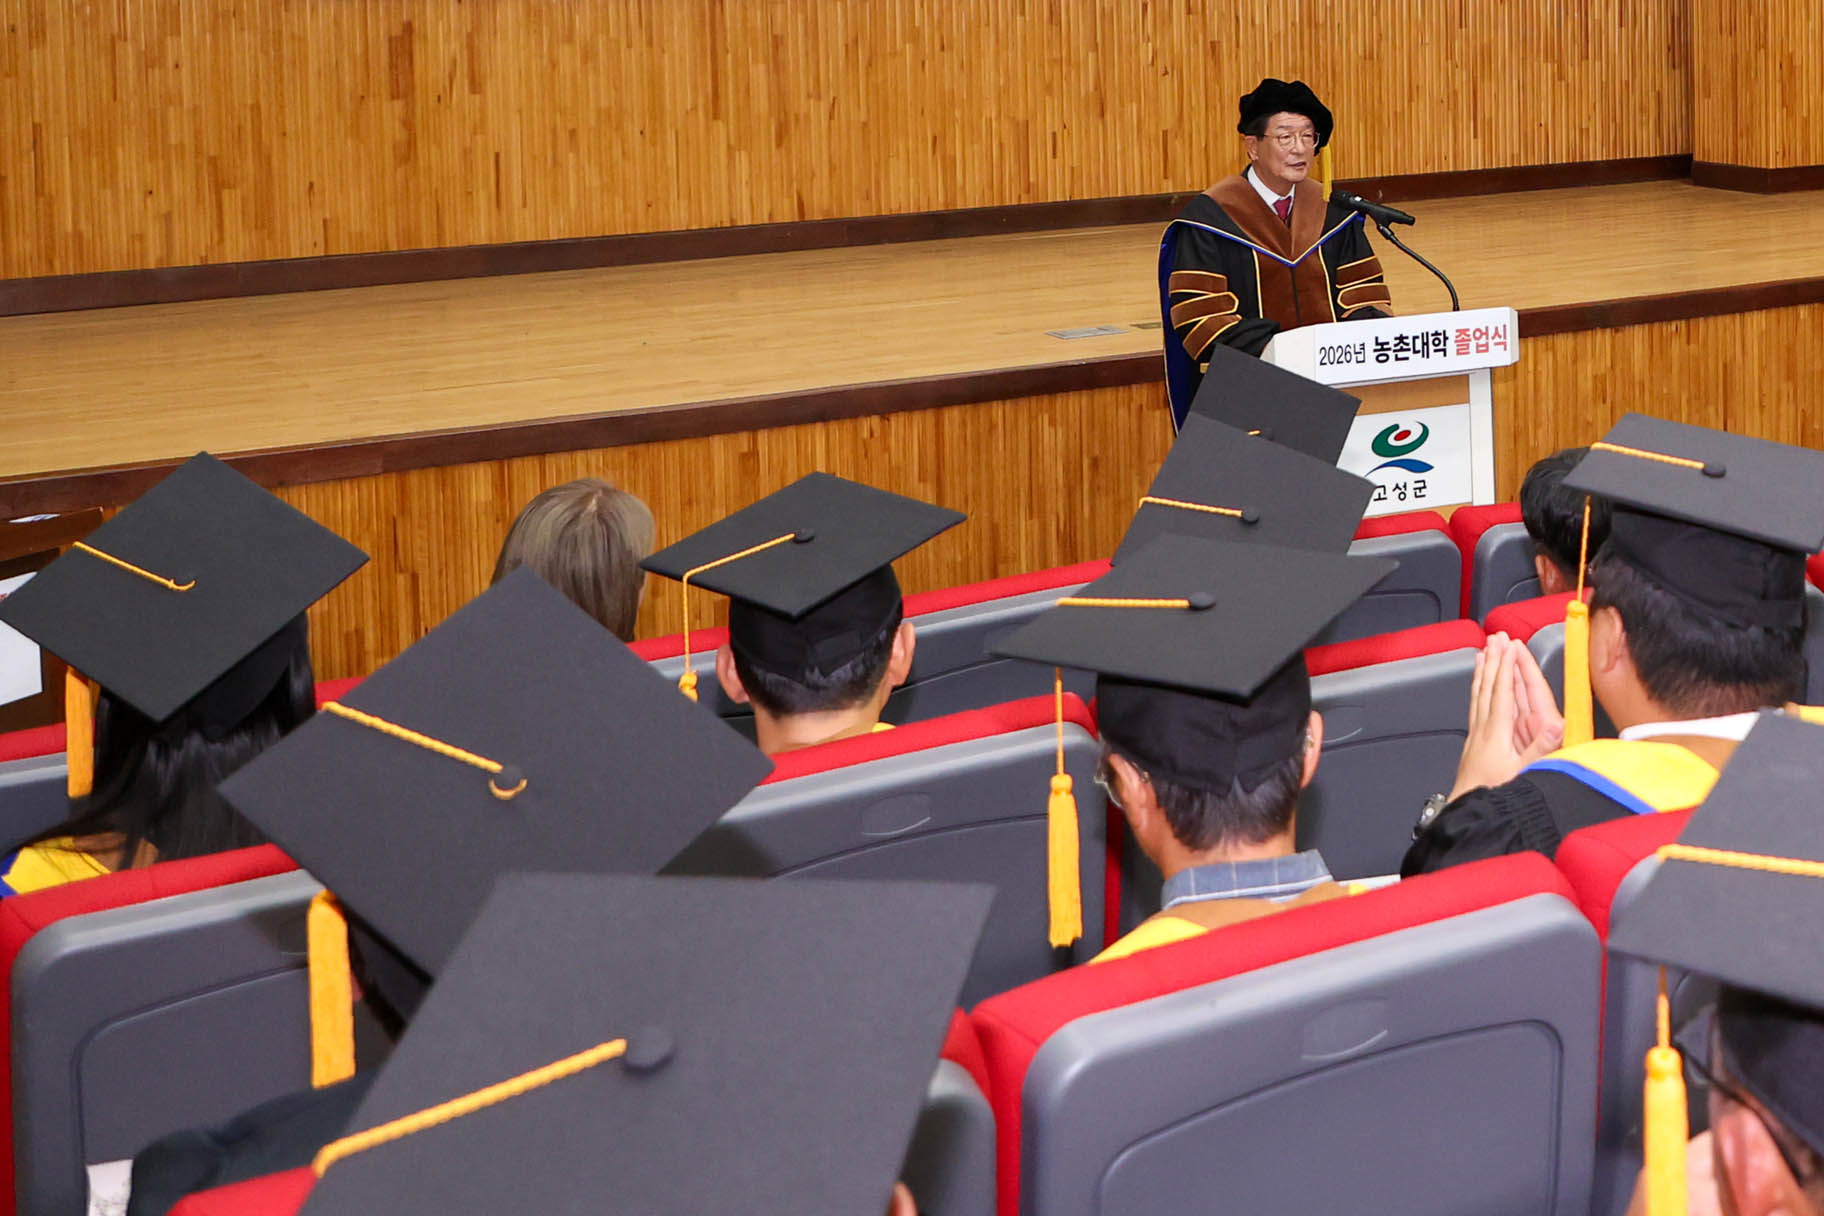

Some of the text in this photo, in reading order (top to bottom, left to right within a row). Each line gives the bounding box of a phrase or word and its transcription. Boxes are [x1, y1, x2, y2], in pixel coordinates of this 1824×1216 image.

[1319, 324, 1508, 366] 2026년 농촌대학 졸업식
[1373, 479, 1427, 502] 고성군
